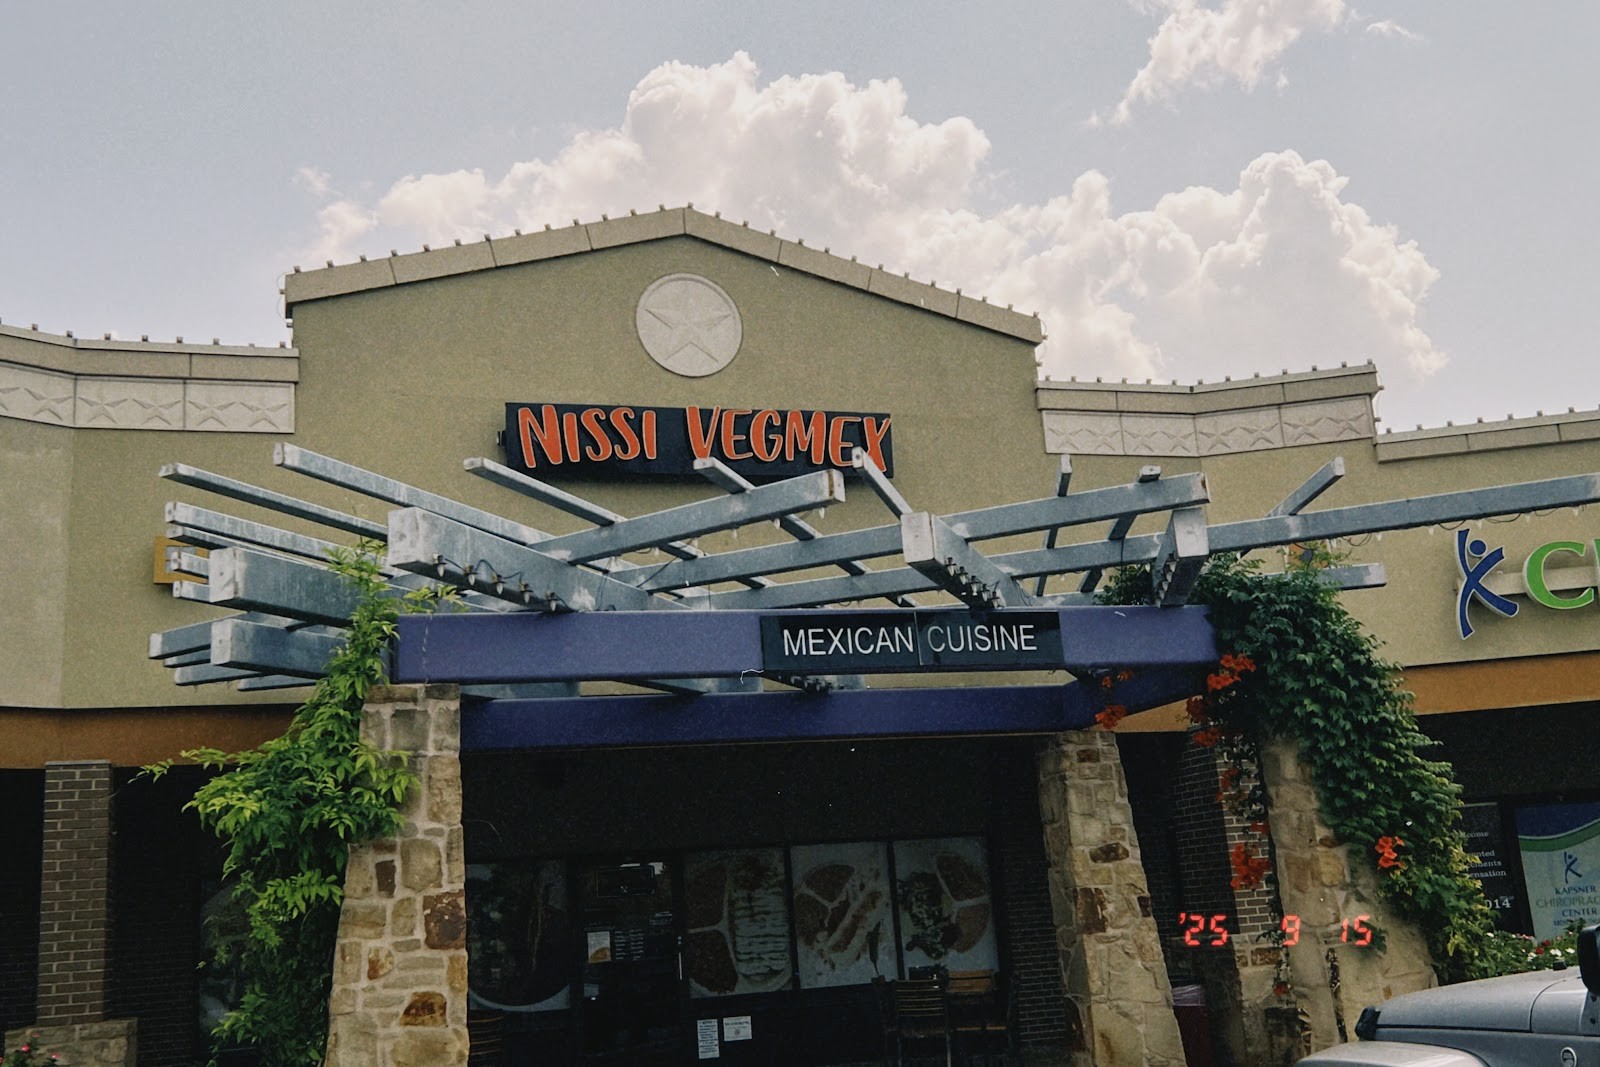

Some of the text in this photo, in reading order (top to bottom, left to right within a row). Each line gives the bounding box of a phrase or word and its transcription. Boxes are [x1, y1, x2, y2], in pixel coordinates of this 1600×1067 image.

[517, 404, 892, 472] NISSI VEGMEX
[1523, 538, 1600, 610] C
[783, 624, 1037, 656] MEXICAN CUISINE
[1555, 885, 1597, 895] KAPSNER
[1561, 908, 1598, 917] CENTER
